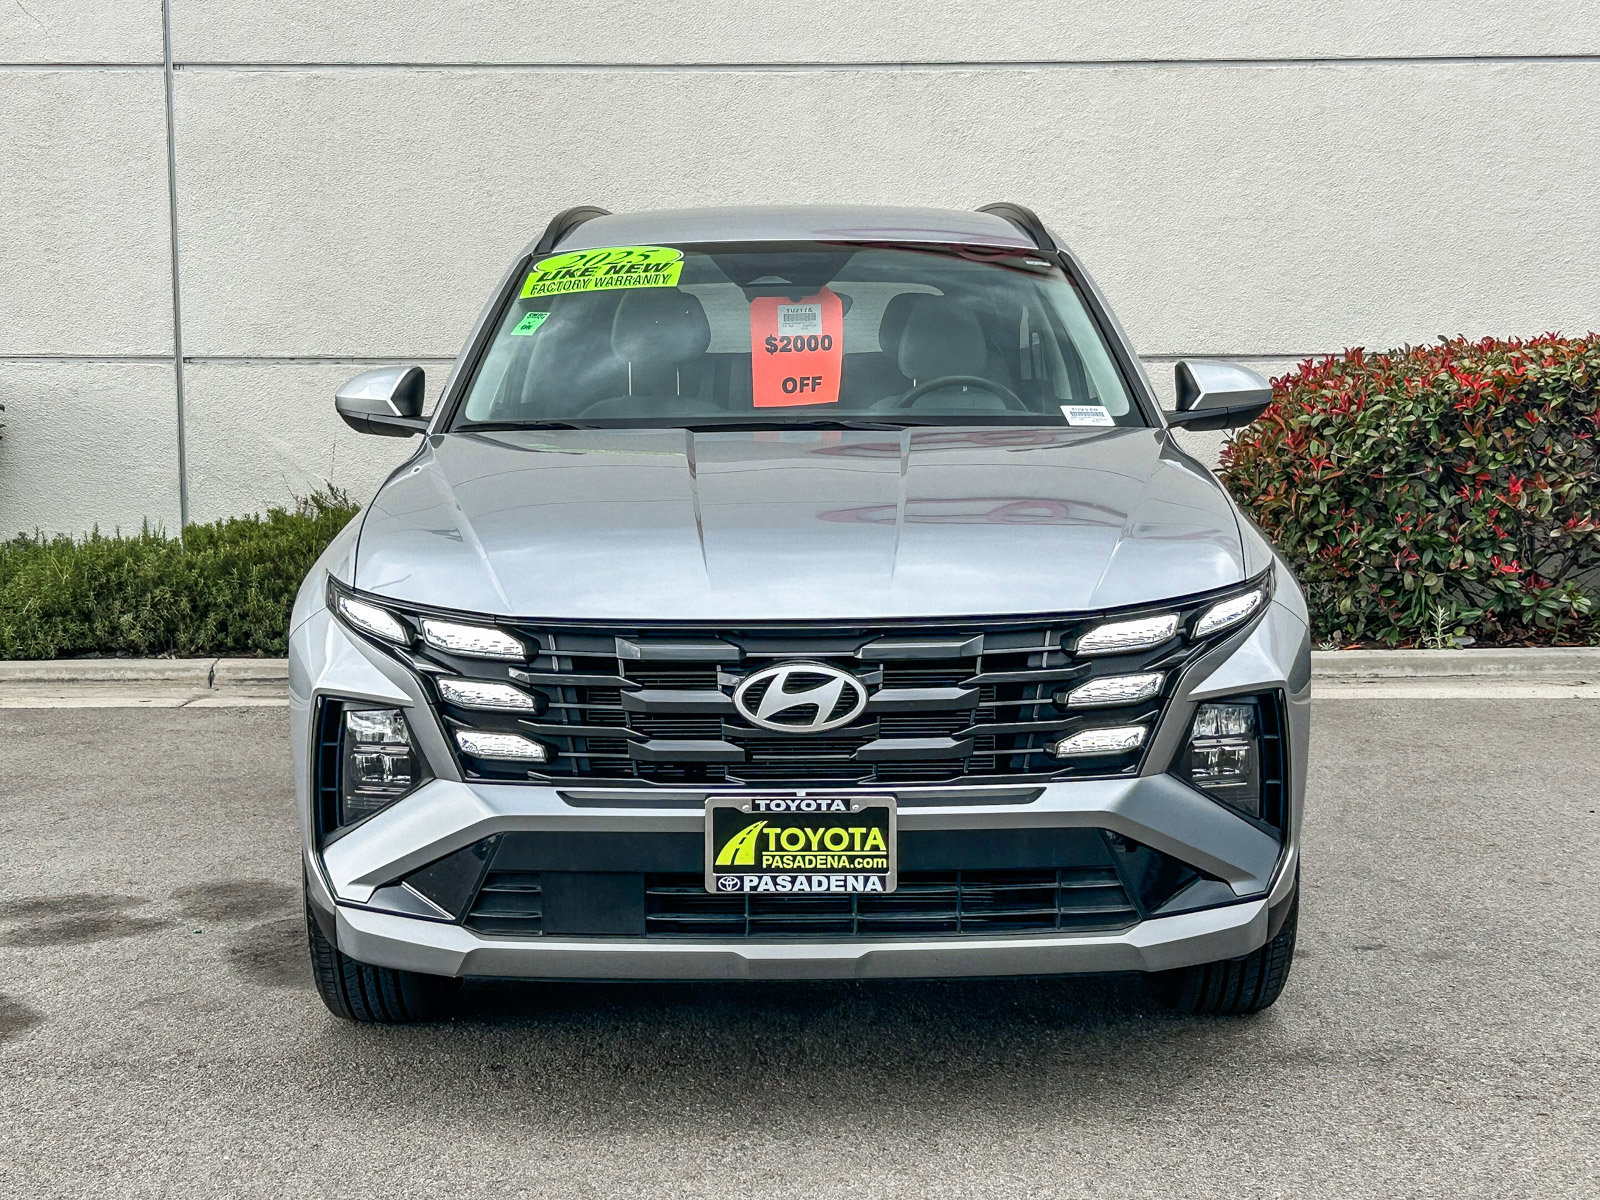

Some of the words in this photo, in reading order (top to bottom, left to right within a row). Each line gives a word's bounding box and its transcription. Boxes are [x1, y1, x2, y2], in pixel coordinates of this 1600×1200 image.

[558, 249, 660, 271] 2025
[536, 265, 600, 283] LIKE
[603, 262, 675, 276] NEW
[530, 278, 592, 296] FACTORY
[594, 273, 672, 288] WARRANTY
[765, 334, 833, 356] $2000
[781, 376, 822, 394] OFF
[755, 800, 846, 811] TOYOTA
[762, 827, 887, 851] TOYOTA
[762, 855, 887, 869] PASADENA.com
[743, 876, 883, 892] PASADENA
